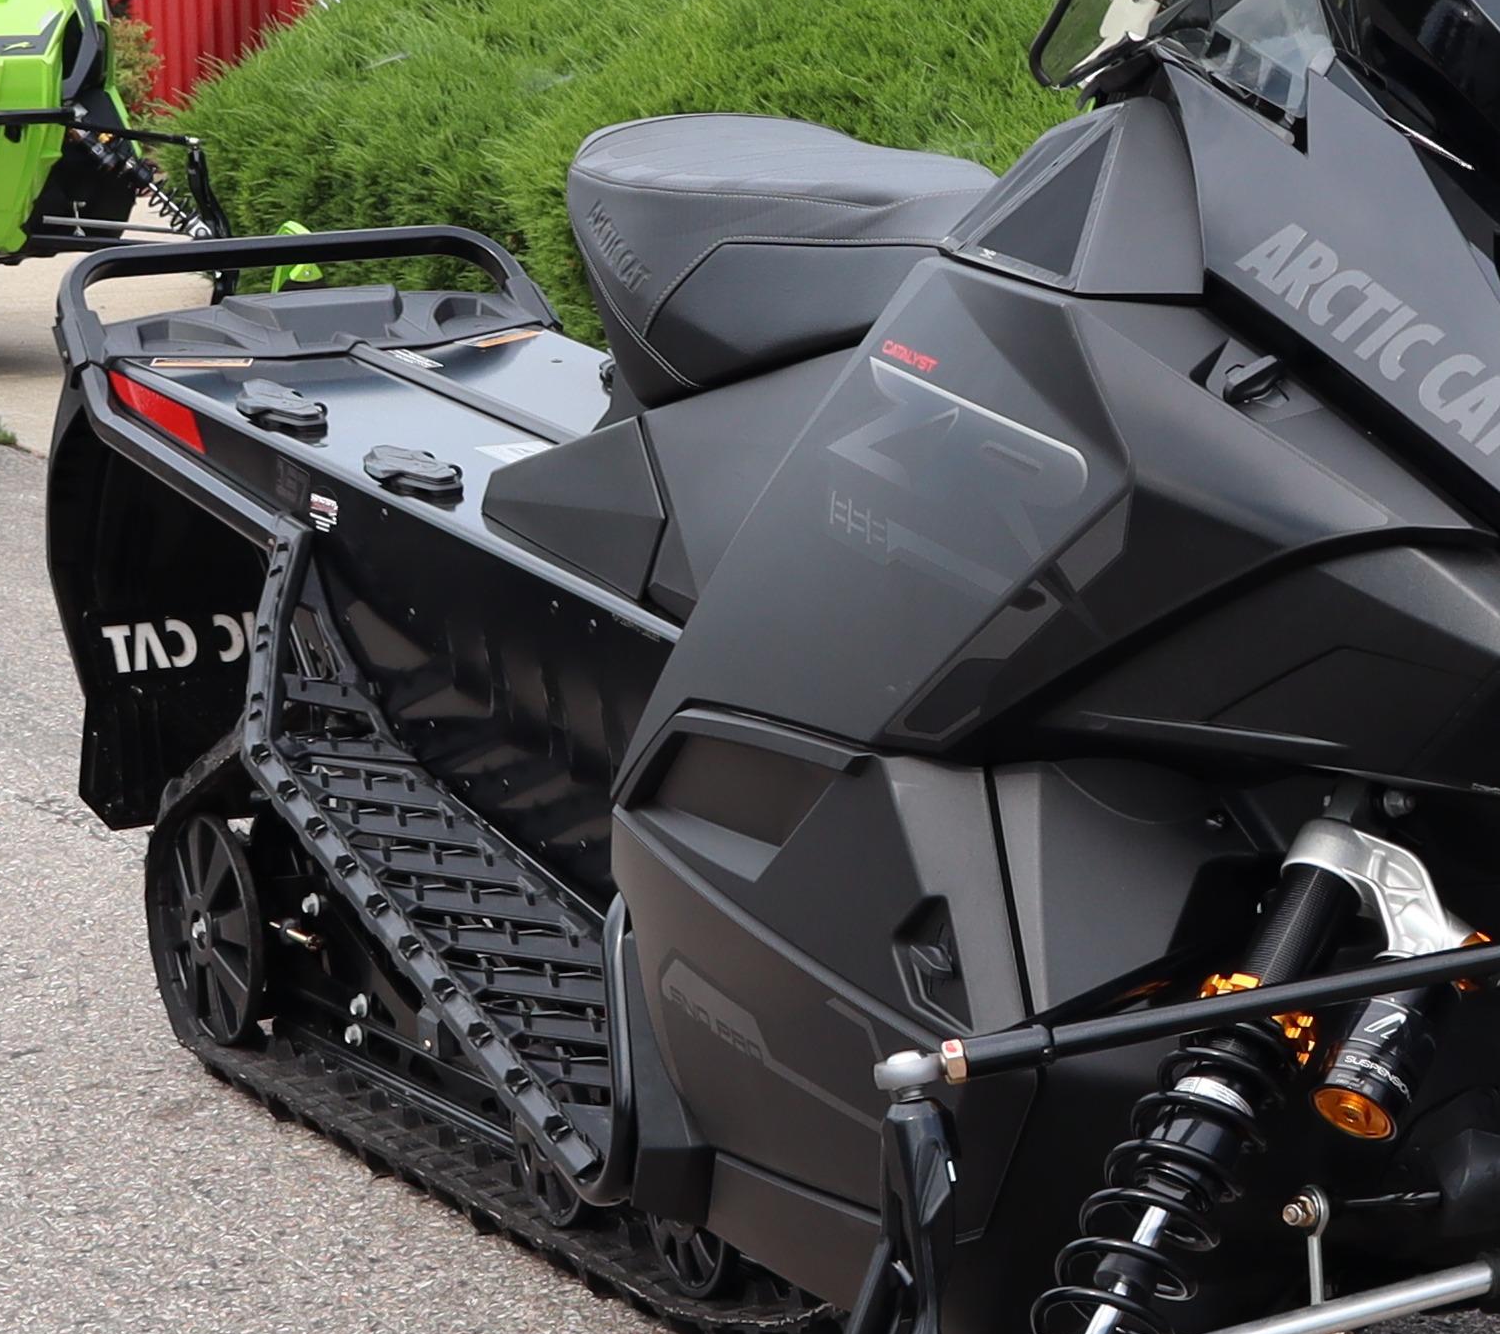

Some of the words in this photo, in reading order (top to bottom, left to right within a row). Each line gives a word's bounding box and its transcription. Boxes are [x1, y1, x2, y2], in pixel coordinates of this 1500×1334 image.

[586, 198, 624, 267] ARCTIC
[616, 249, 652, 295] CAT
[1234, 223, 1446, 381] ARCTIC
[881, 339, 939, 374] CATALYST
